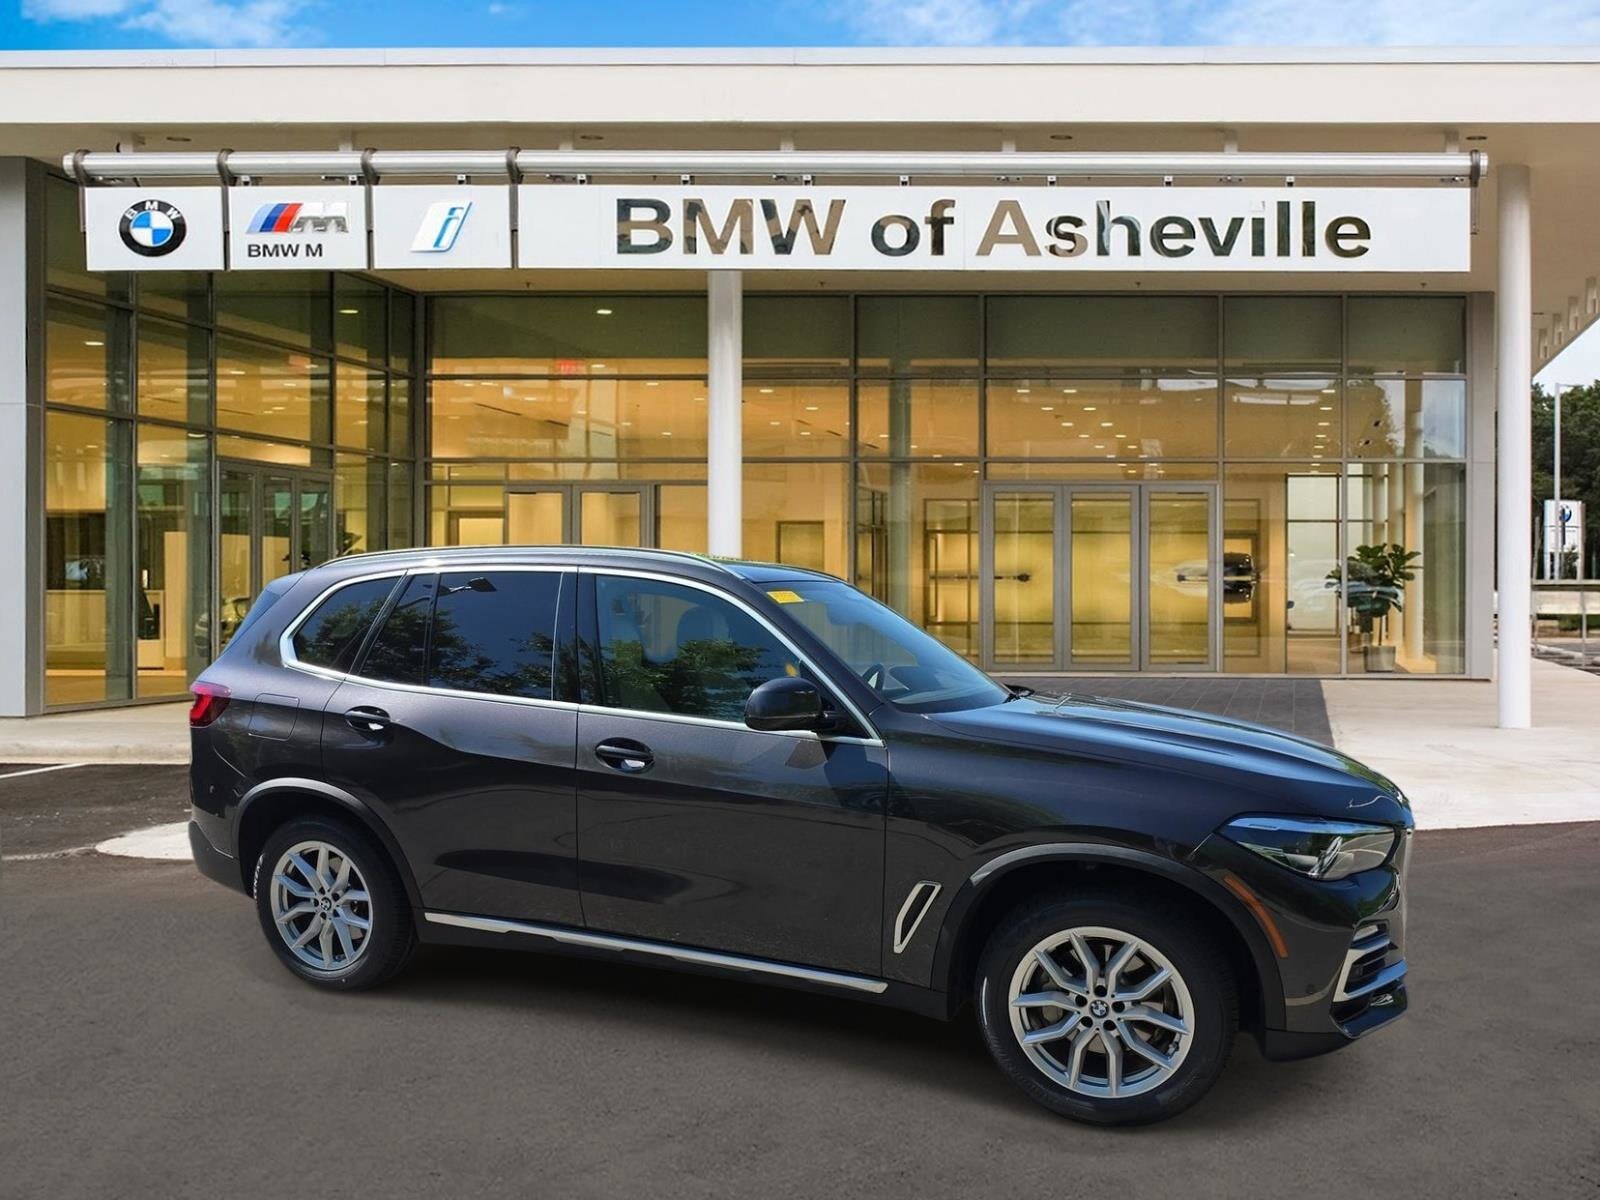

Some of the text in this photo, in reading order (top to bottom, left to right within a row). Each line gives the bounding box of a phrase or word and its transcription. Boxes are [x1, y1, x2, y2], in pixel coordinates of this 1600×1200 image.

[124, 201, 181, 220] BMW
[616, 198, 1372, 258] BMW of Asheville
[247, 243, 323, 258] BMW M
